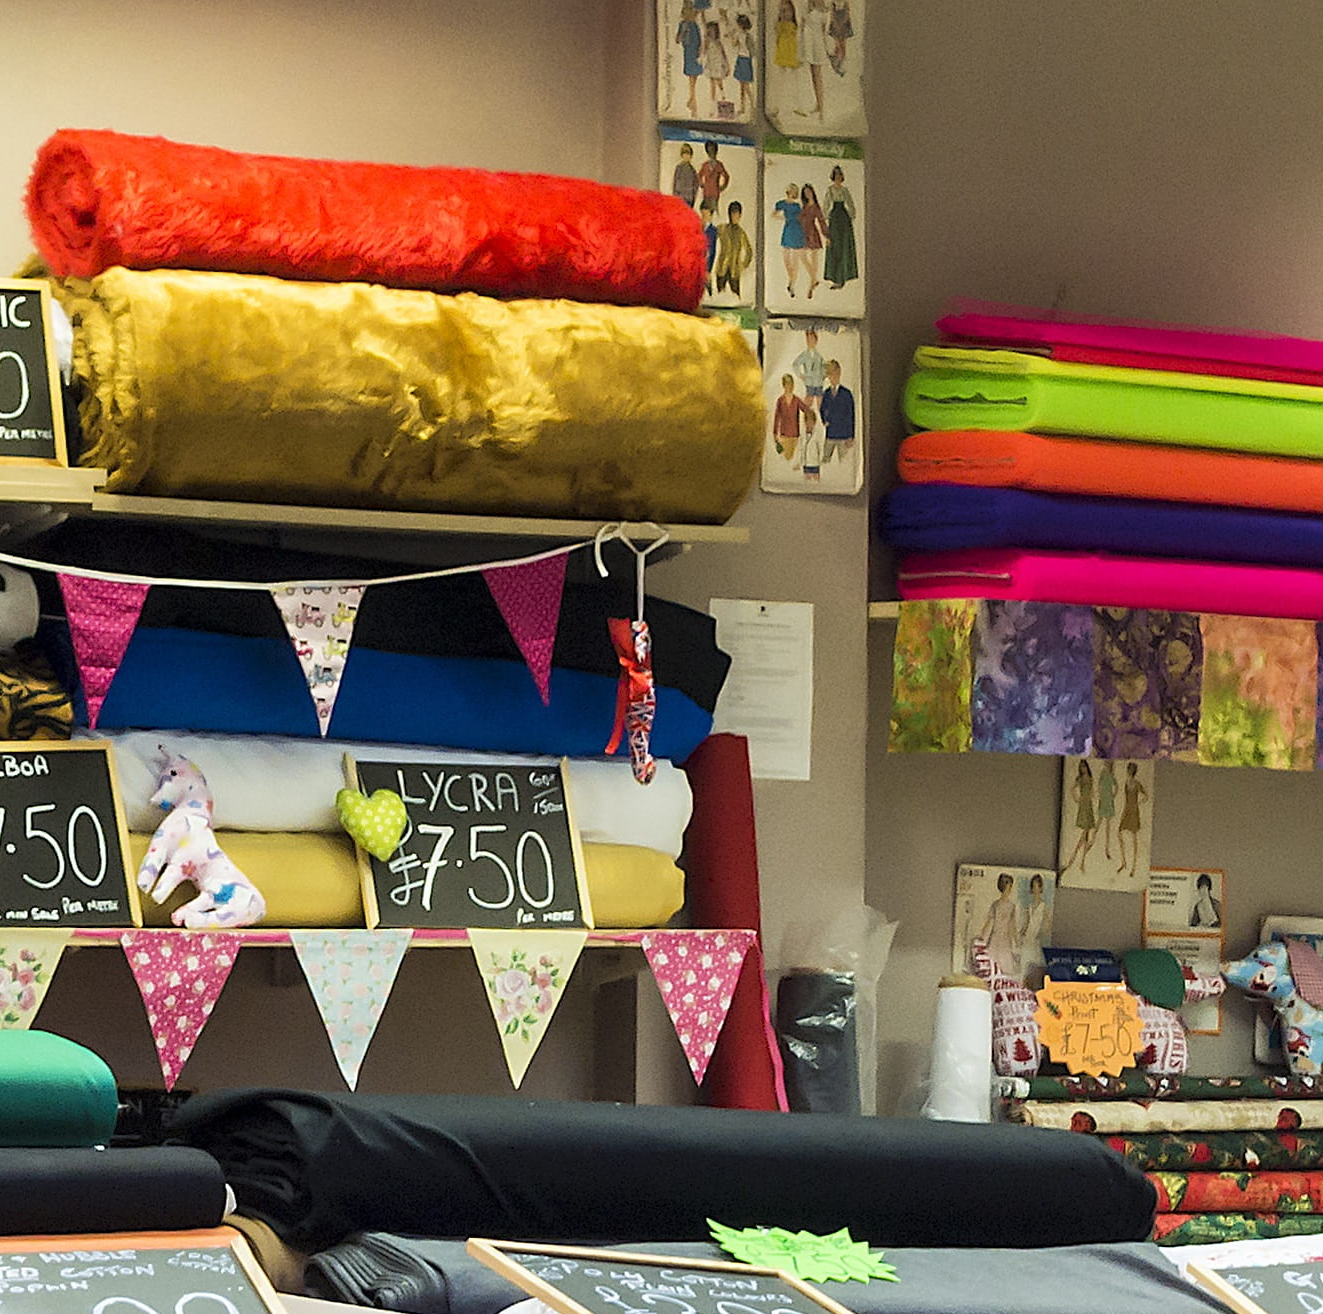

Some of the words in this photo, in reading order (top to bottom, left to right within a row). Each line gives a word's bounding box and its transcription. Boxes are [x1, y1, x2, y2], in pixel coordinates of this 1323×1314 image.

[396, 769, 520, 812] LYCRA
[39, 1250, 137, 1264] HUBBLE
[59, 1263, 155, 1279] COTTON
[659, 1269, 759, 1291] COTTON
